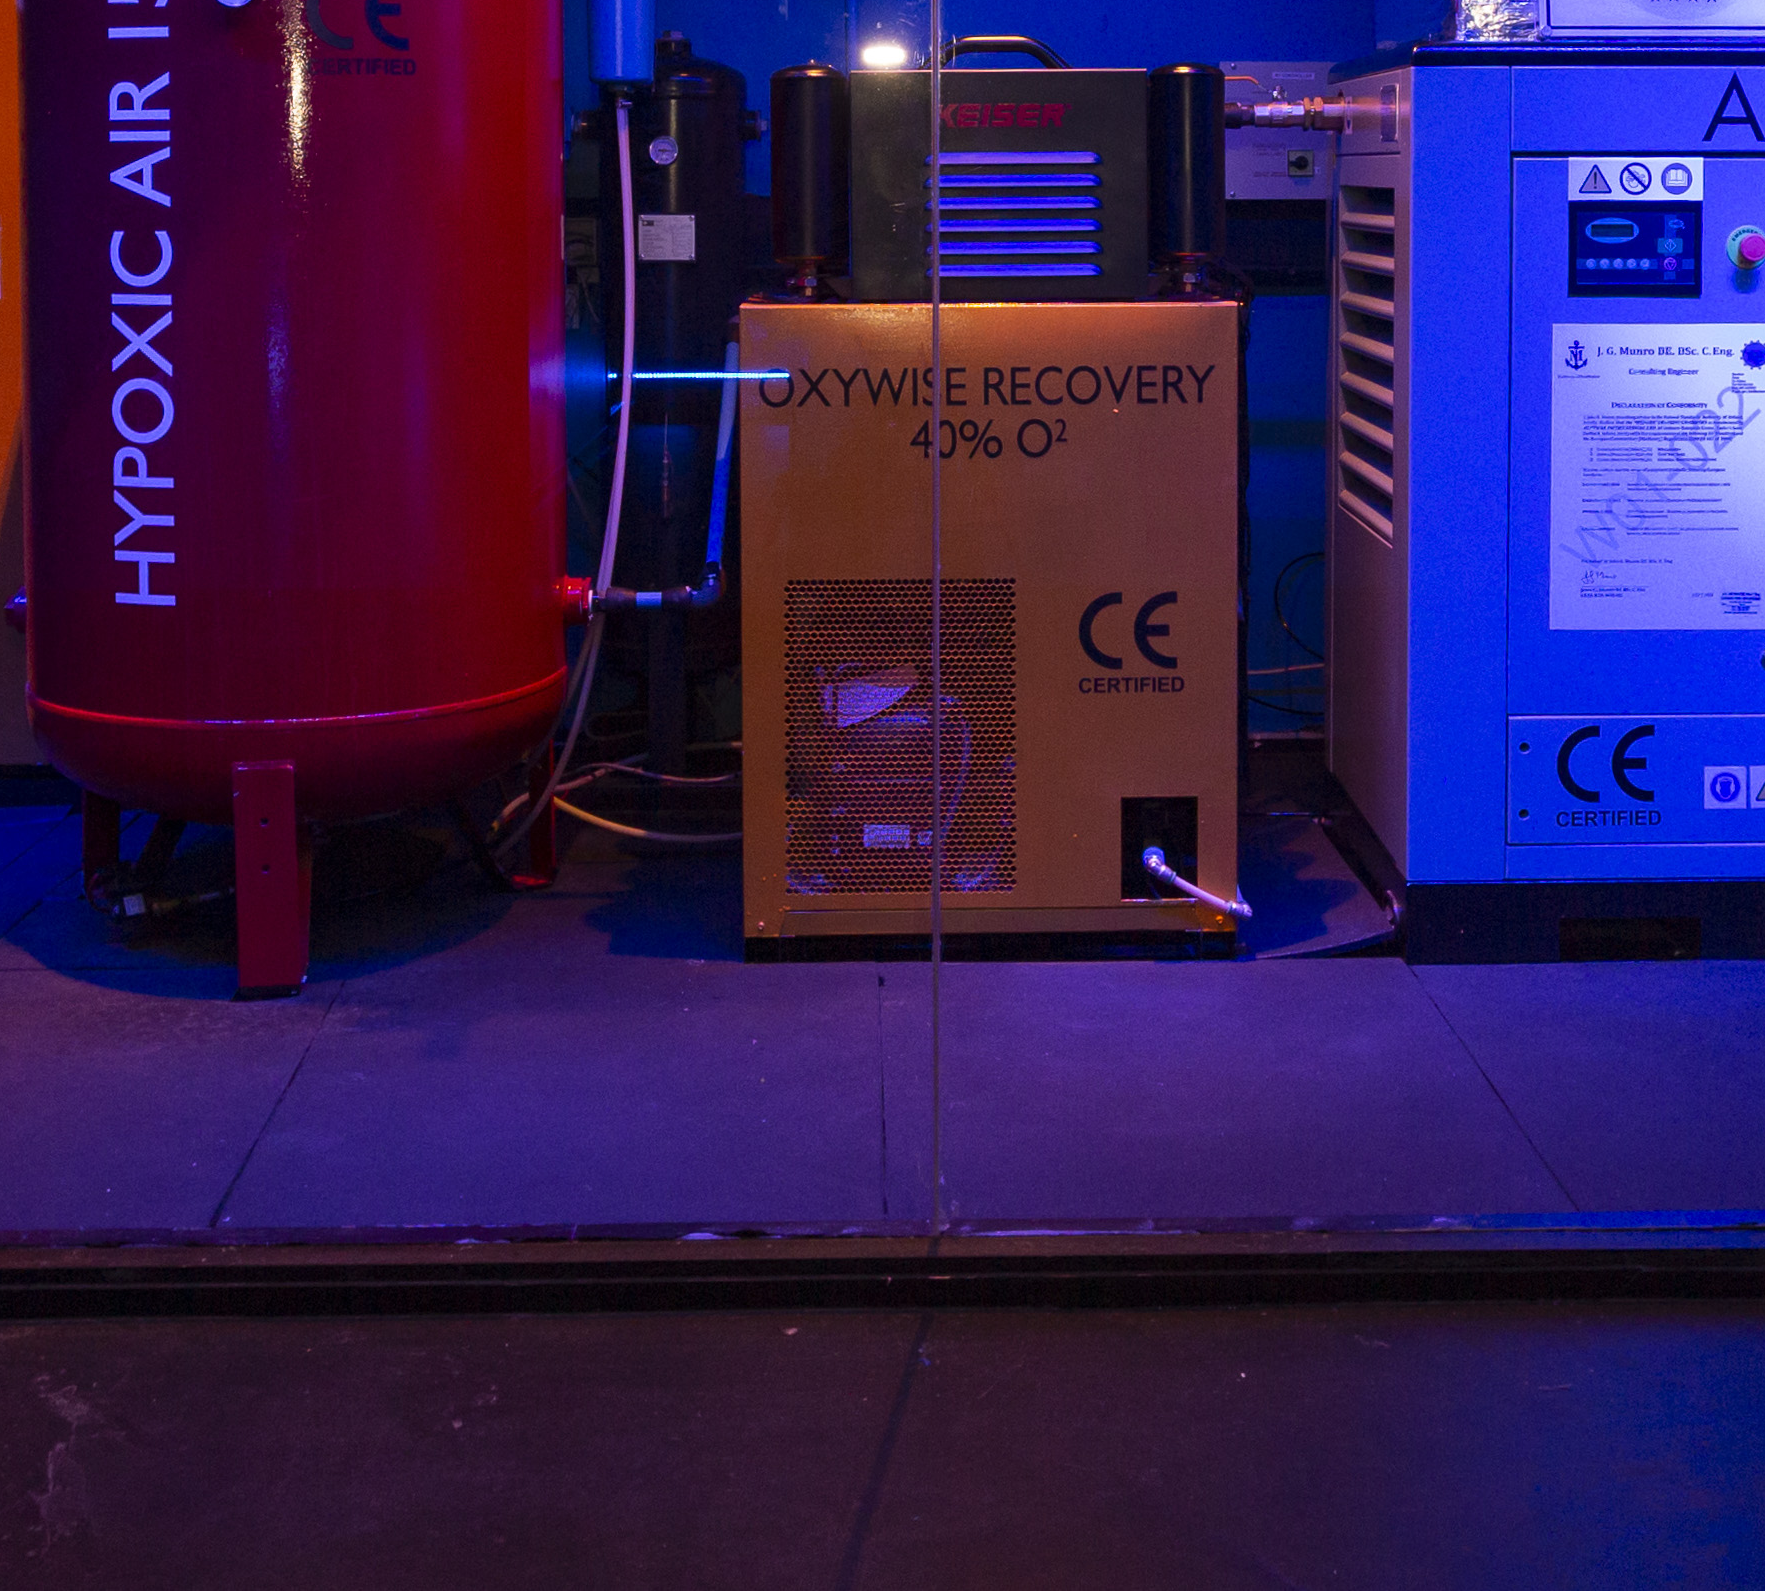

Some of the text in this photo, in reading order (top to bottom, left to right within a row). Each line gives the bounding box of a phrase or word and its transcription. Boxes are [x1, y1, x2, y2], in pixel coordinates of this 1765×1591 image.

[940, 103, 1065, 127] KEISER
[109, 72, 172, 207] AIR
[1619, 347, 1654, 356] Munro
[759, 364, 1215, 408] OXYWISE RECOVERY
[110, 229, 176, 607] HYPOXIC
[910, 419, 1003, 460] 40%
[1078, 676, 1185, 693] CERTIFIED
[1556, 810, 1662, 828] CERTIFIED
